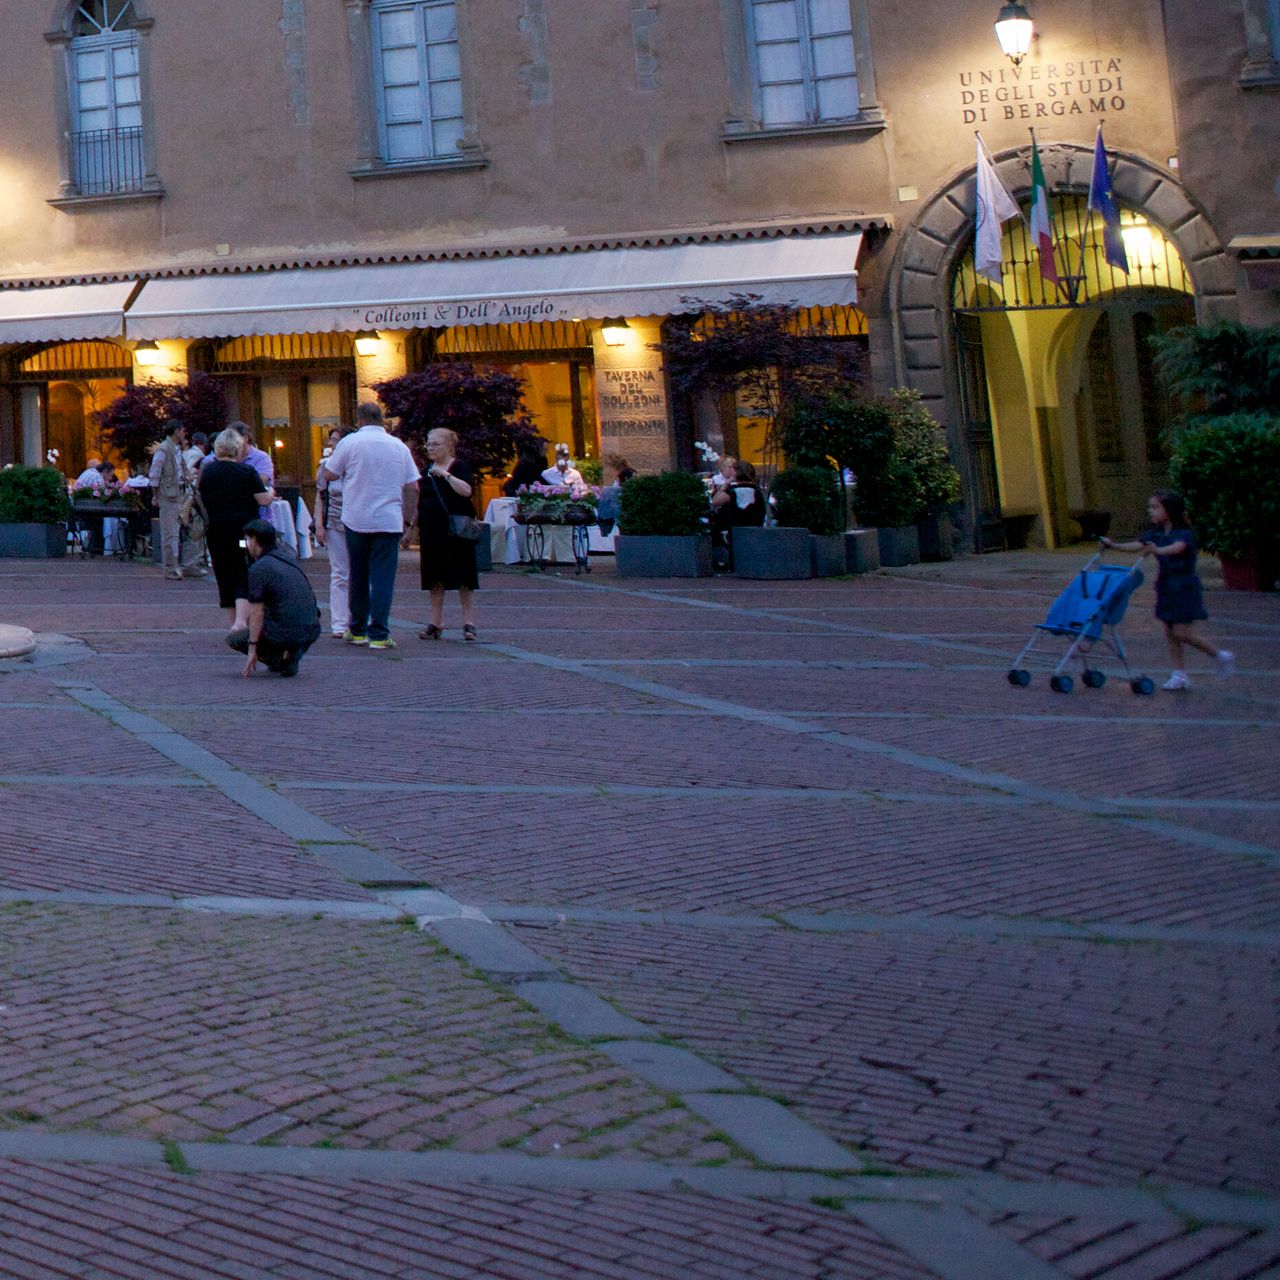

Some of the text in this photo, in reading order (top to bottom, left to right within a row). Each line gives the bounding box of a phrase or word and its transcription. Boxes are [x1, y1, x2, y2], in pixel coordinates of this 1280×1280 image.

[960, 76, 1123, 105] DEGLI STUDI
[962, 95, 1126, 124] DI BERGAMO
[434, 304, 451, 321] &
[604, 370, 656, 383] TAVERNA
[619, 382, 643, 395] DEL
